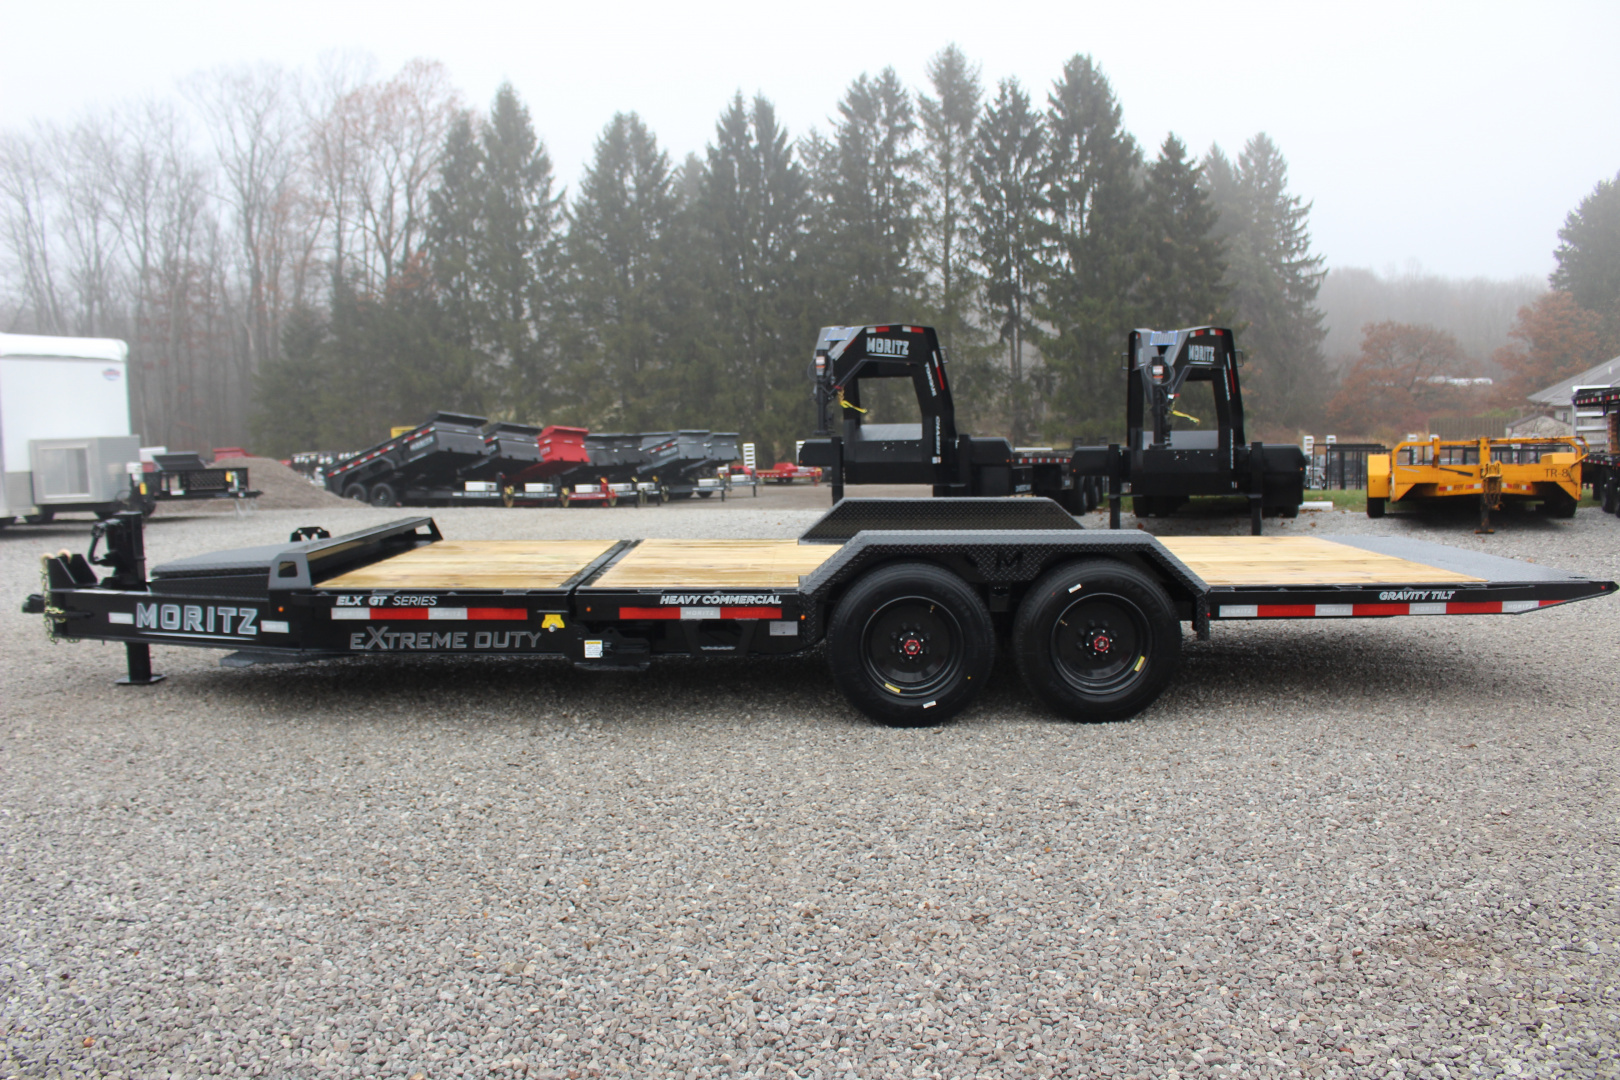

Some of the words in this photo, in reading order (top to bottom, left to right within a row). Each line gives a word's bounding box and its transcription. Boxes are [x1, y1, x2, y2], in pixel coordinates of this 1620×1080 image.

[866, 336, 909, 356] MORITZ
[1188, 344, 1215, 361] MORITZ
[336, 595, 362, 606] ELX
[368, 596, 388, 606] GT
[392, 596, 437, 606] SERIES
[660, 595, 701, 605] HEAVY
[702, 595, 782, 605] COMMERCIAL
[1379, 590, 1429, 601] GRAVITY
[1431, 590, 1456, 600] TILT
[135, 602, 258, 636] MORITZ
[474, 631, 542, 650] DUTY
